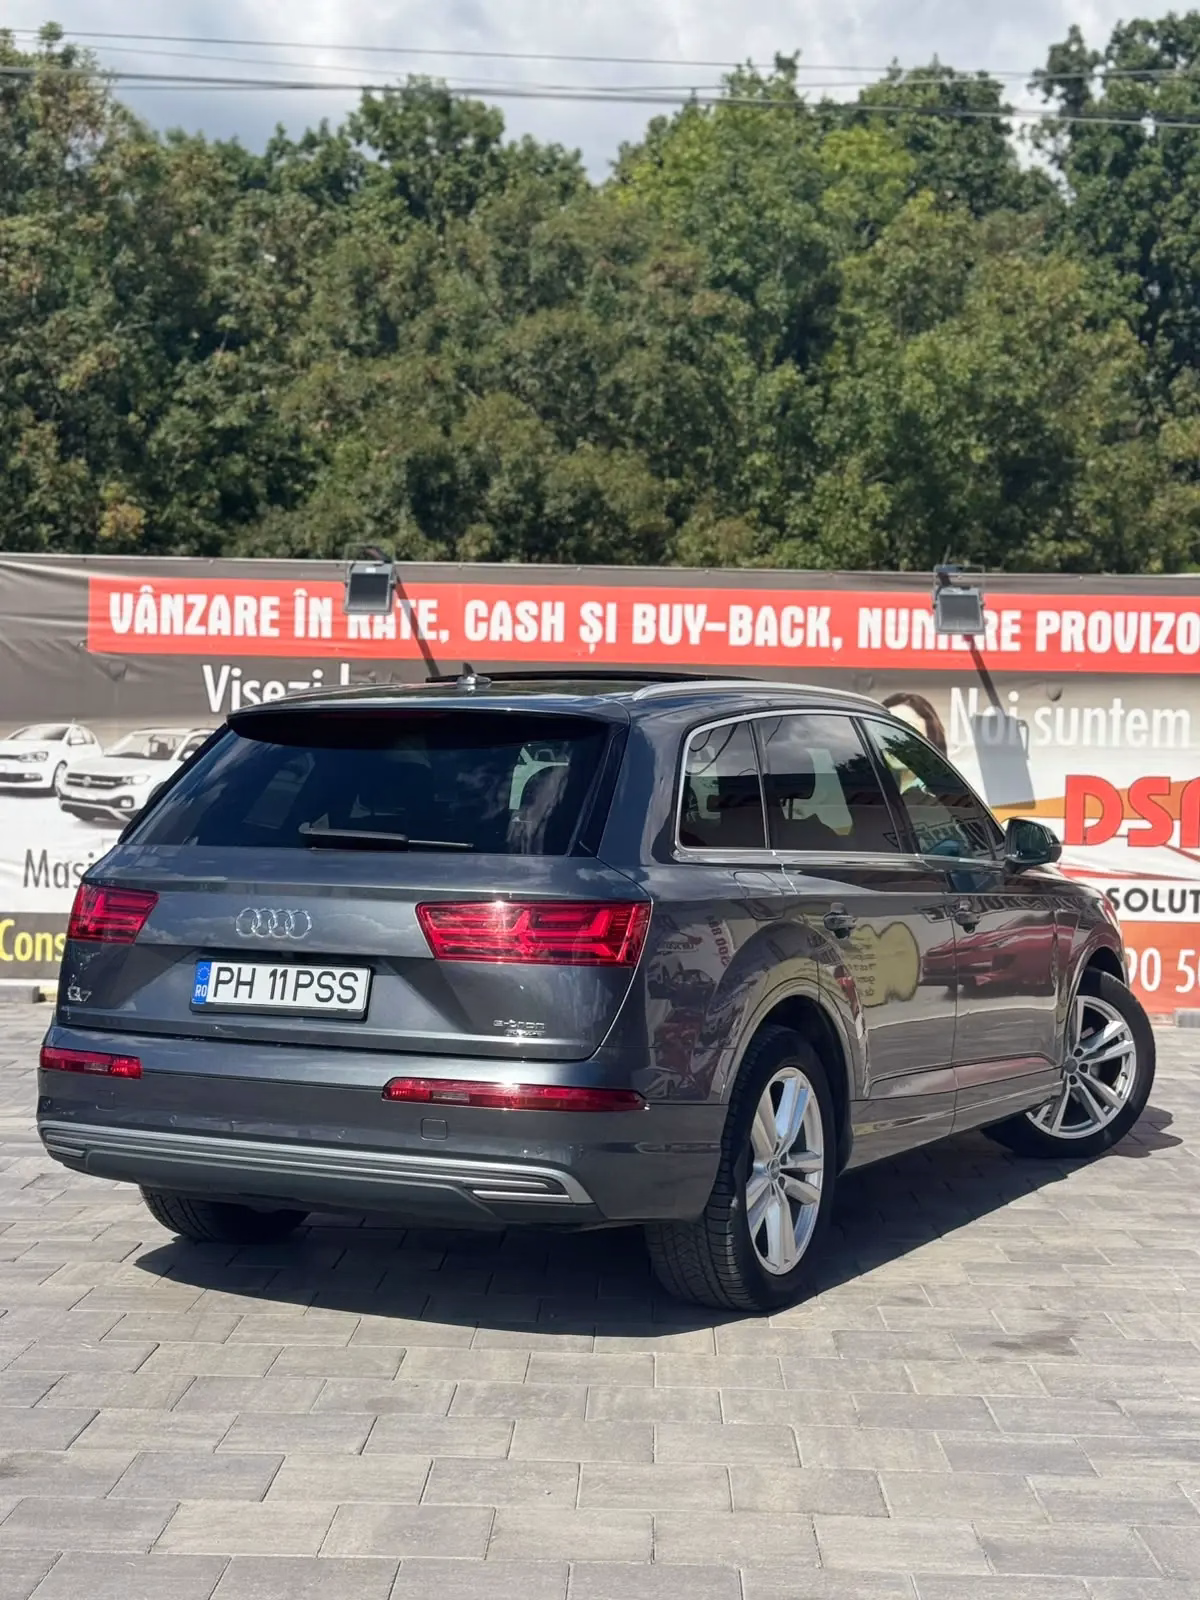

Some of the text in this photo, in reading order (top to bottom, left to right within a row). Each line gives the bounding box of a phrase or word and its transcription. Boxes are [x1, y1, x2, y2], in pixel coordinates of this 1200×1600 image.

[109, 584, 281, 637] VÂNZARE
[294, 588, 333, 638] ÎN
[464, 599, 565, 643] CASH
[632, 603, 843, 652] BUY-BACK,
[1035, 610, 1200, 655] PROVIZO
[949, 687, 1190, 748] Noi suntem
[195, 984, 207, 997] RO
[213, 966, 256, 999] PH
[1175, 949, 1200, 993] 5
